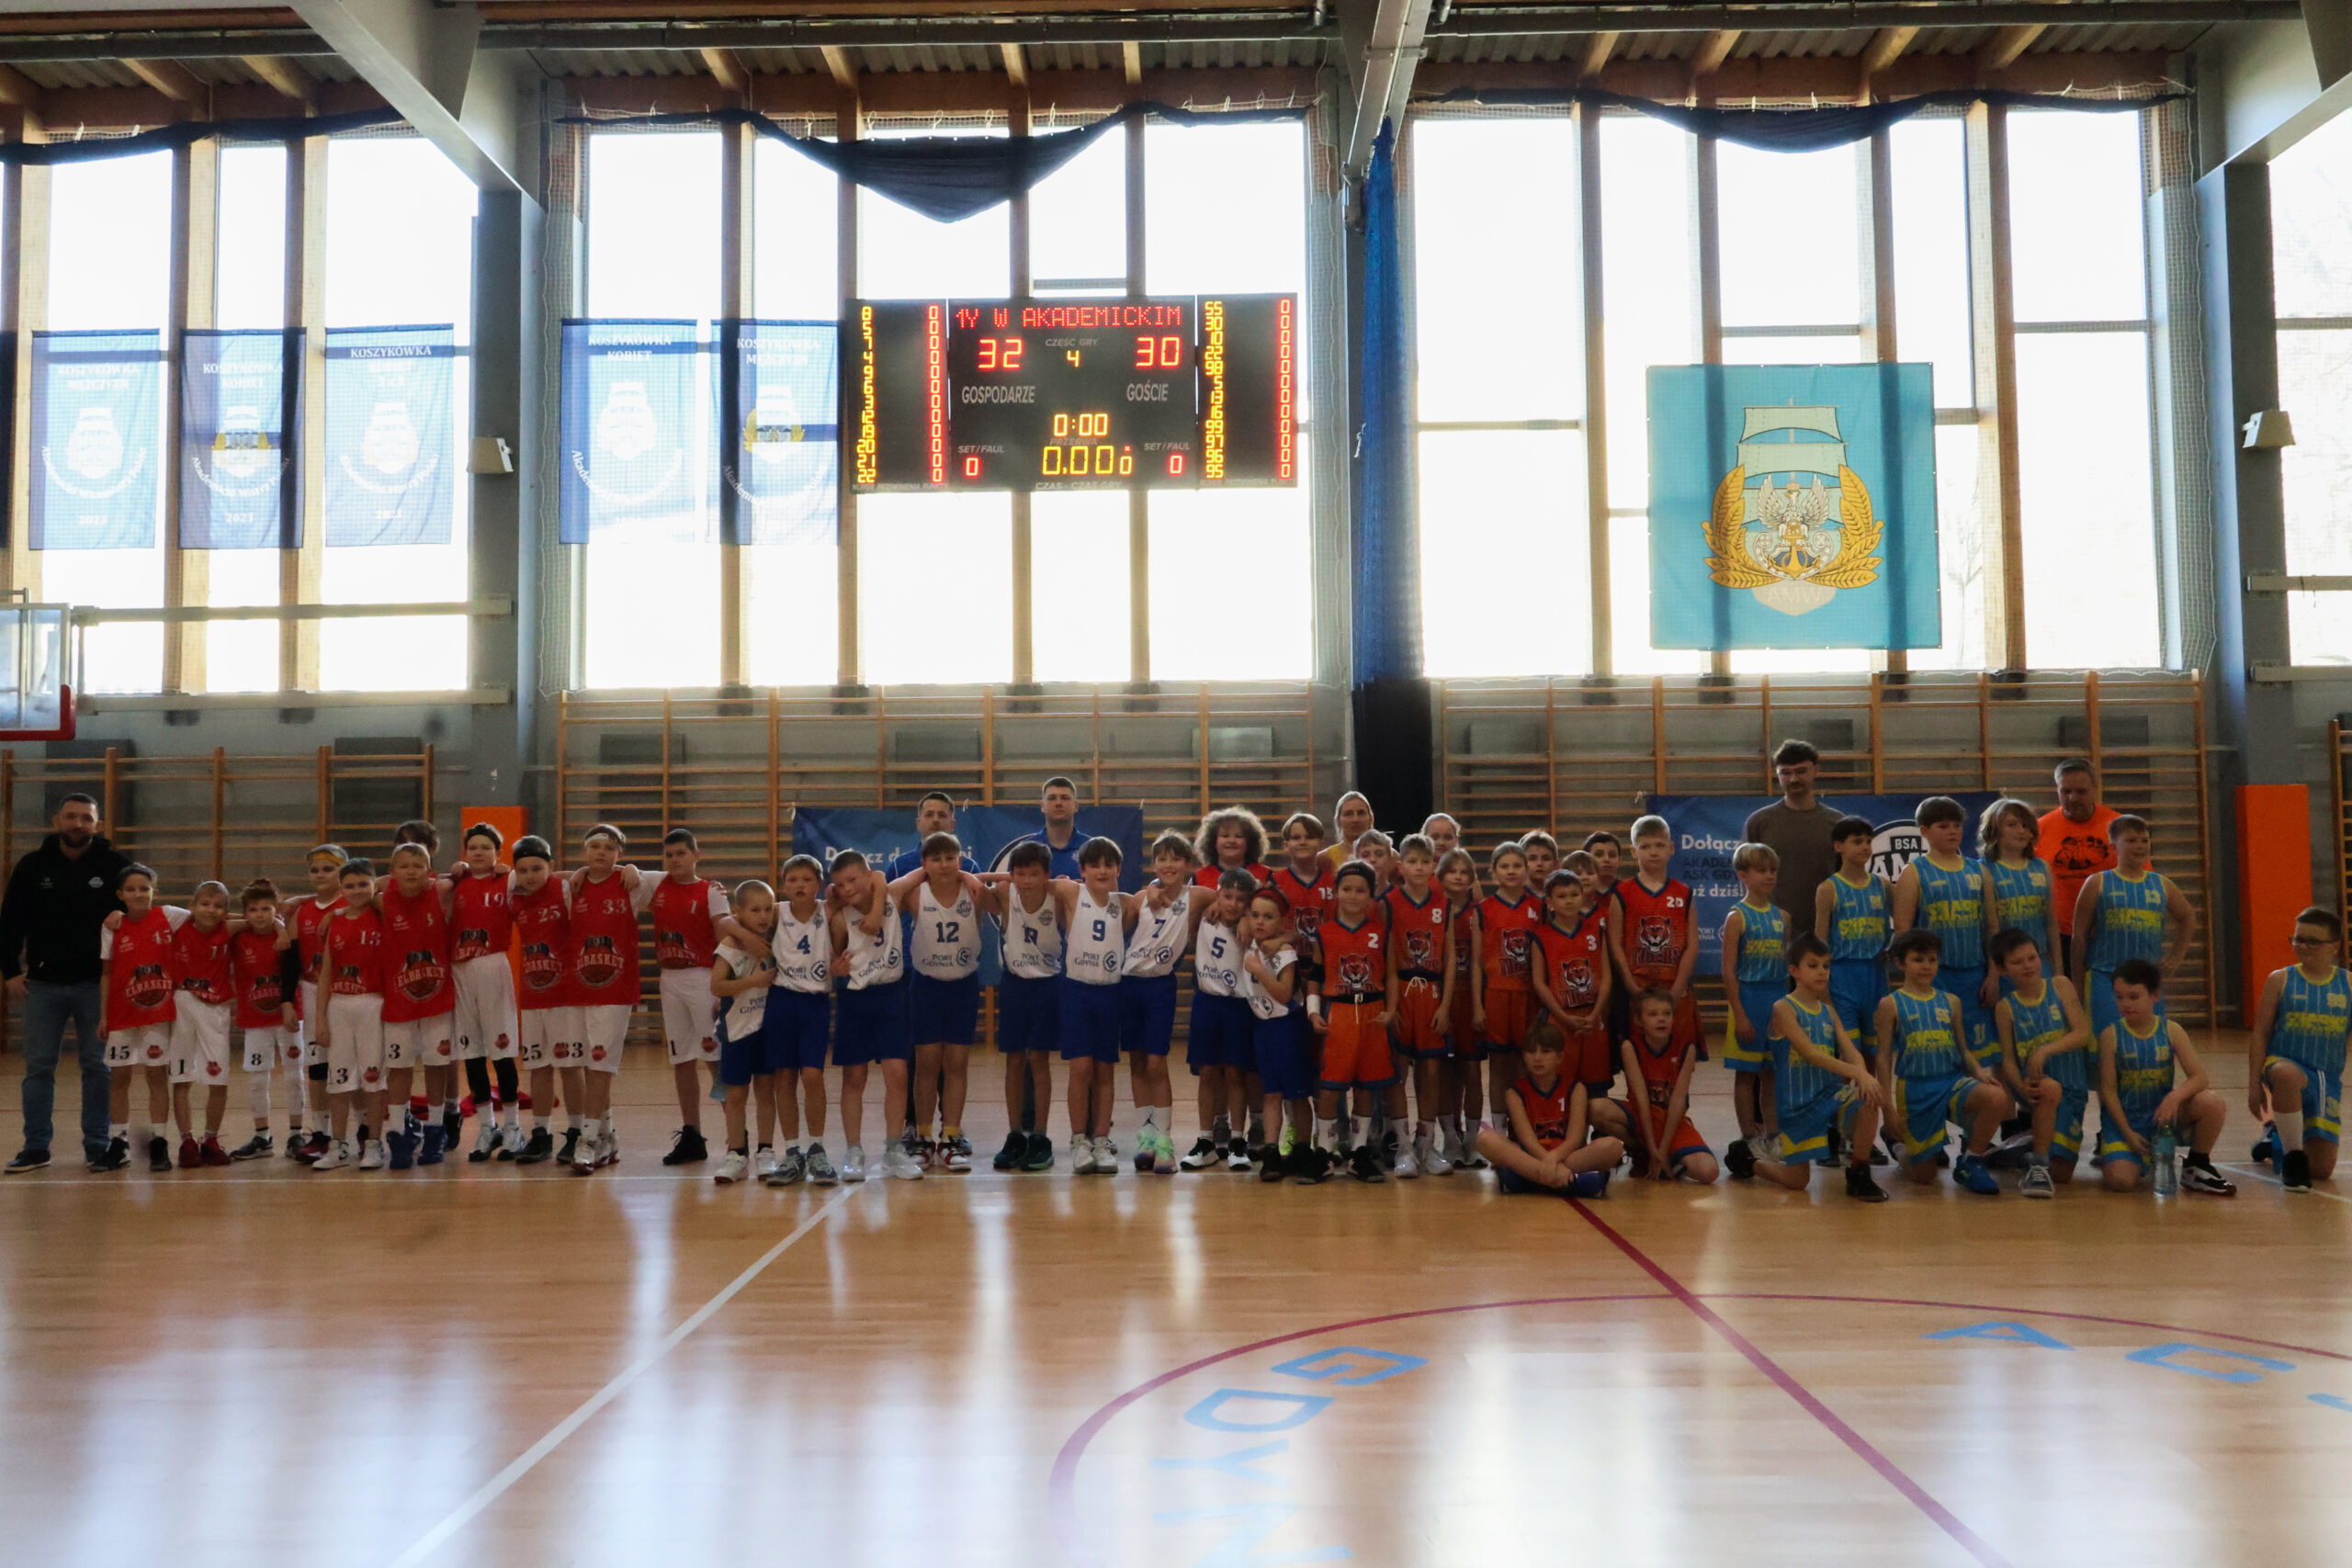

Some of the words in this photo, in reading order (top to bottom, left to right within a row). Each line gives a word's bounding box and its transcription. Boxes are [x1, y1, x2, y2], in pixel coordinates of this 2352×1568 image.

[929, 306, 938, 320] 0
[1281, 299, 1290, 313] 0
[862, 306, 872, 321] 8
[993, 308, 1010, 329] W
[1022, 306, 1182, 328] AKADEMICKIM
[863, 321, 872, 335] 5
[930, 321, 938, 334] 0
[1281, 315, 1290, 329] 0
[864, 336, 872, 350] 7
[930, 335, 939, 349] 0
[1079, 337, 1100, 346] GRY
[1281, 330, 1290, 344] 0
[350, 344, 432, 358] KOSZYKÓWKA
[863, 351, 873, 364] 4
[930, 350, 939, 364] 0
[978, 339, 1023, 368] 32
[1136, 336, 1180, 367] 30
[1281, 344, 1290, 358] 0
[1067, 350, 1080, 367] 4
[864, 366, 873, 379] 9
[931, 365, 939, 378] 0
[1281, 359, 1290, 373] 0
[864, 380, 873, 394] 6
[931, 379, 940, 393] 0
[1281, 375, 1290, 389] 0
[962, 386, 1035, 403] GOSPODARZE
[1126, 379, 1169, 401] GOŚCIE
[1281, 389, 1290, 403] 0
[864, 395, 874, 410] 3
[932, 395, 940, 408] 0
[932, 409, 941, 423] 0
[1281, 404, 1290, 418] 0
[862, 424, 875, 438] 19
[932, 423, 941, 437] 0
[1054, 413, 1108, 436] 0:00
[1281, 420, 1290, 433] 0
[857, 439, 875, 453] 20
[933, 439, 941, 453] 0
[1050, 437, 1098, 446] PRZERWA
[1144, 442, 1190, 450] SET/FAUL
[1281, 434, 1290, 448] 0
[957, 445, 1004, 453] SET/FAUL
[1281, 449, 1290, 463] 0
[933, 454, 942, 468] 0
[966, 457, 978, 476] 0
[1170, 456, 1182, 474] 0
[857, 468, 876, 482] 22
[933, 468, 942, 482] 0
[1281, 464, 1290, 478] 0
[1768, 588, 1822, 603] AMW
[1681, 833, 1741, 854] Dołącz
[1894, 838, 1919, 850] BSA
[1709, 883, 1744, 897] dziś!
[483, 892, 504, 908] 19
[603, 898, 627, 915] 33
[1666, 896, 1684, 908] 20
[537, 905, 561, 922] 25
[1431, 908, 1443, 924] 8
[935, 921, 959, 942] 12
[1091, 919, 1106, 942] 9
[1152, 919, 1167, 938] 7
[153, 929, 173, 944] 45
[360, 930, 381, 946] 13
[1367, 933, 1380, 949] 2
[1586, 934, 1598, 951] 3
[797, 934, 810, 954] 4
[1211, 937, 1227, 958] 5
[1082, 952, 1101, 960] PORT
[108, 1045, 130, 1060] 45
[389, 1043, 401, 1059] 3
[669, 1041, 677, 1055] 1
[250, 1053, 262, 1066] 8
[1557, 1097, 1566, 1112] 1
